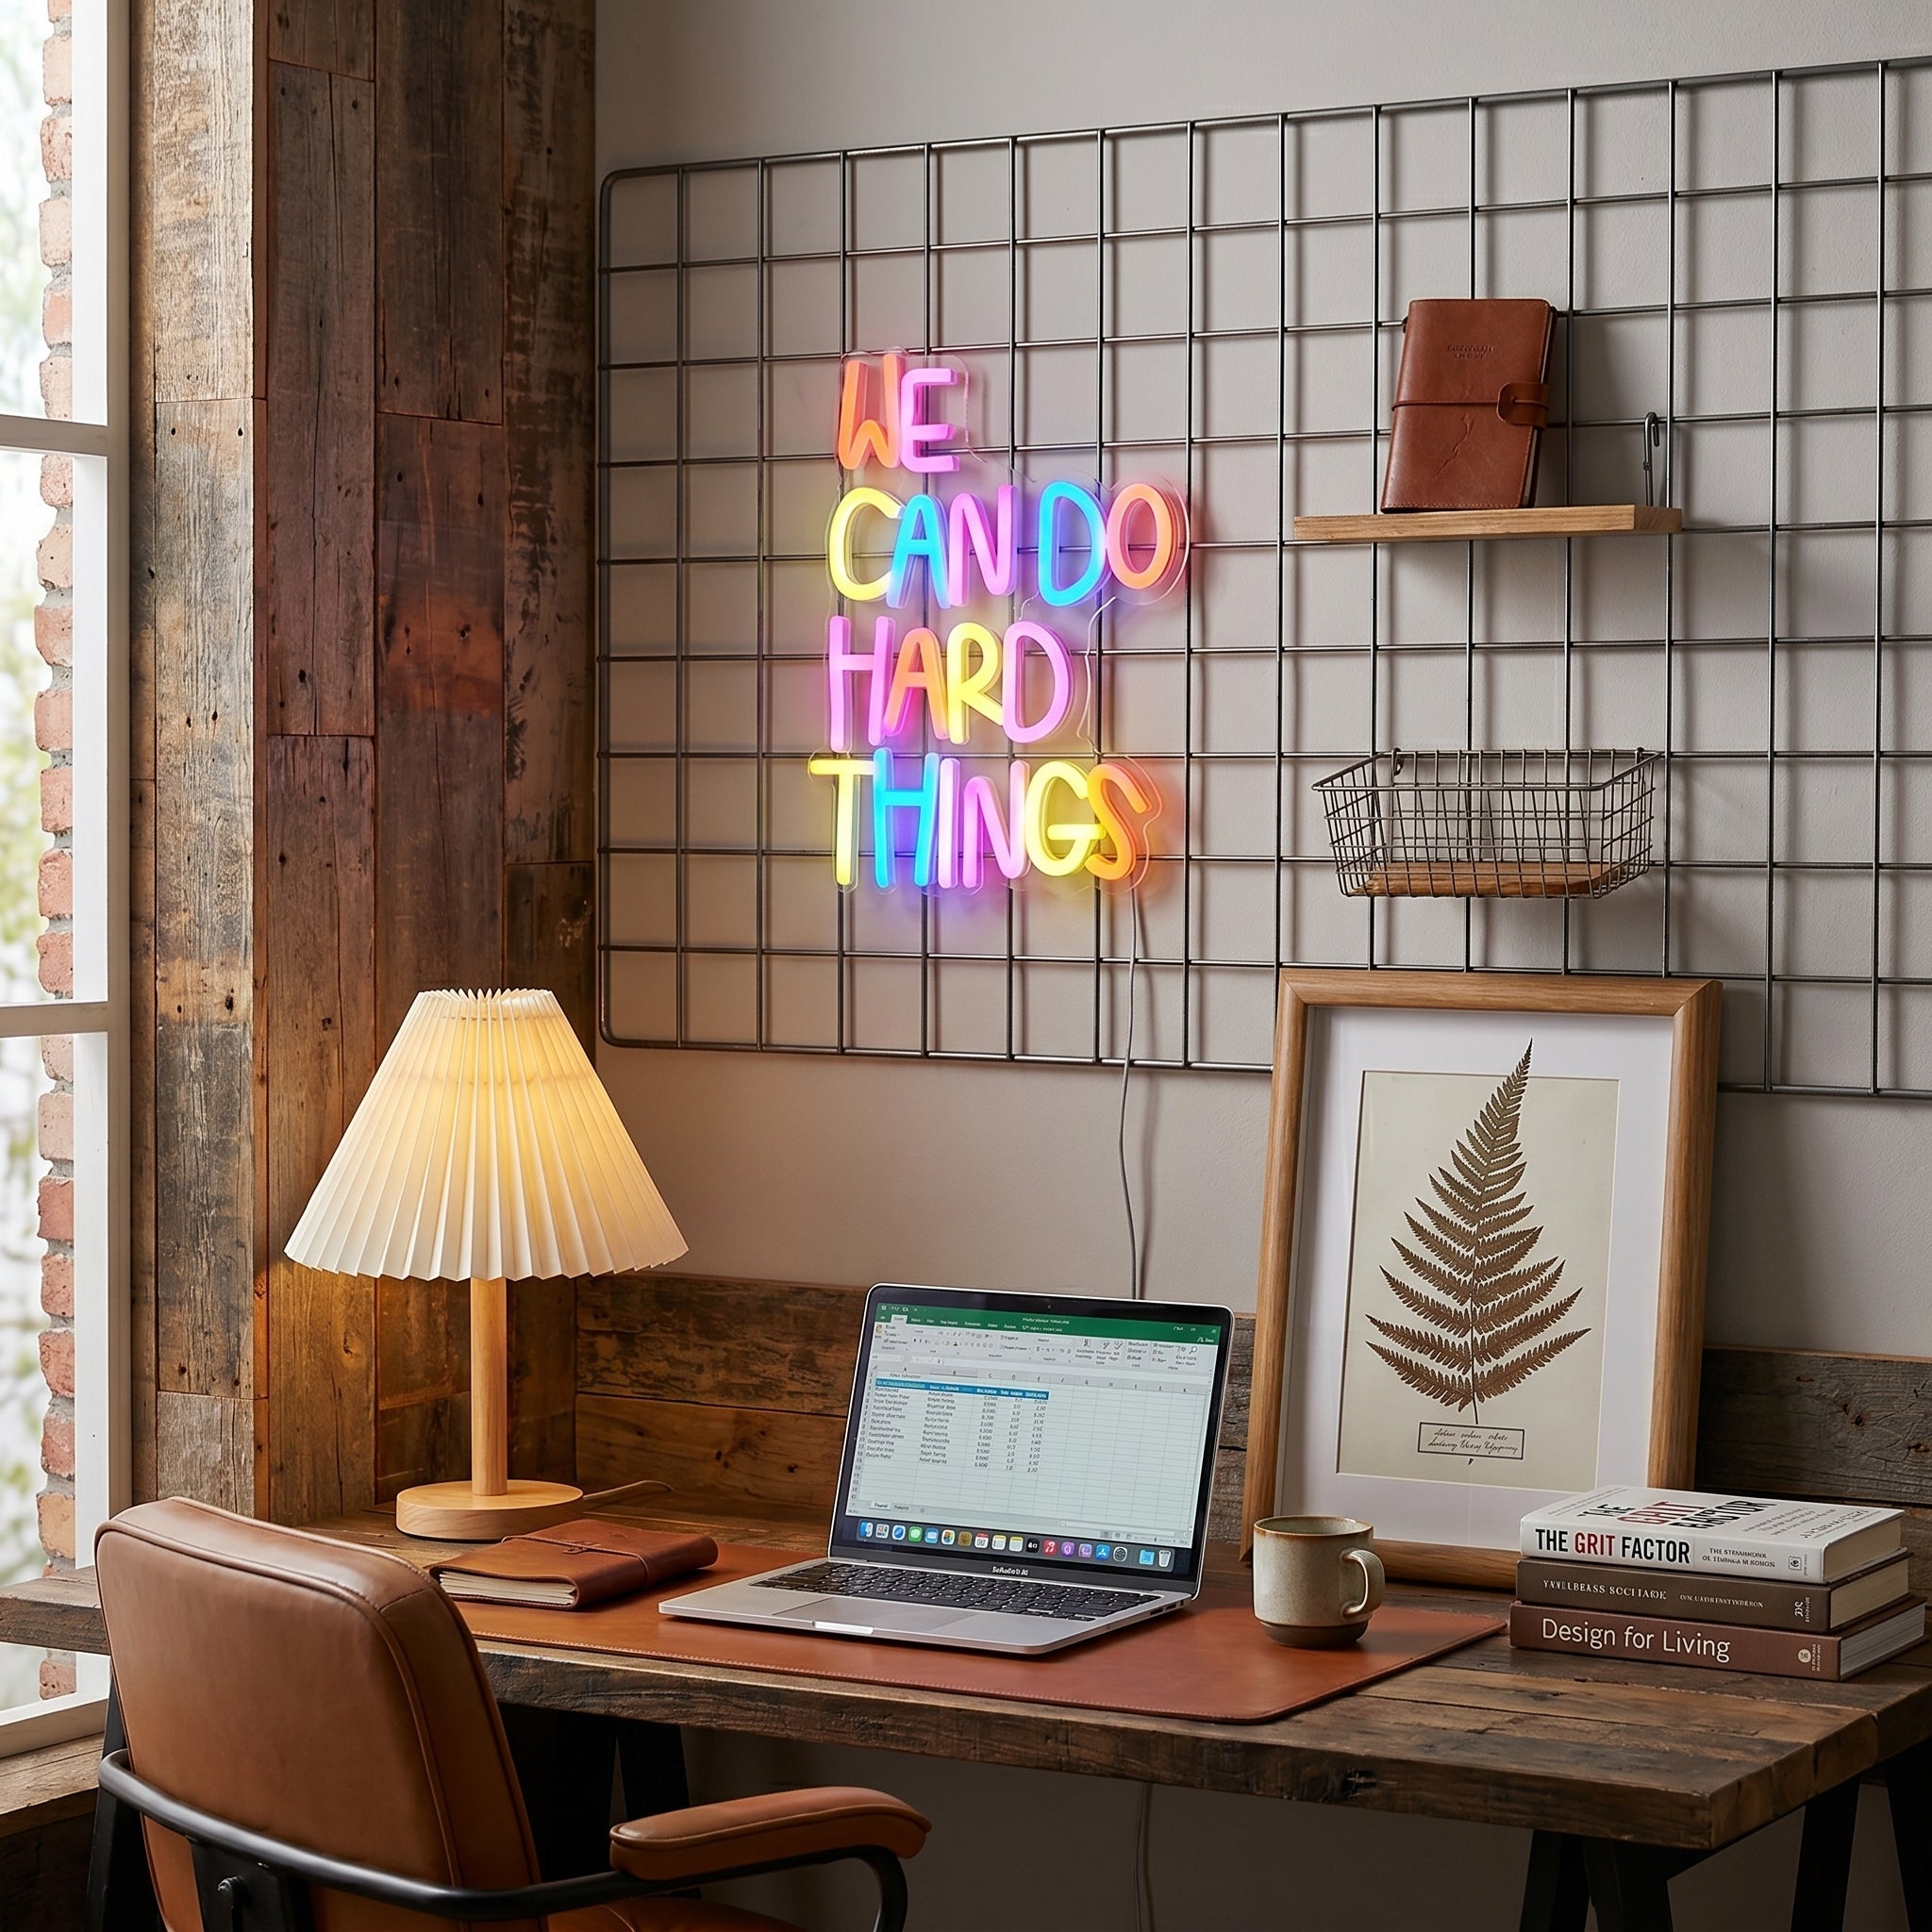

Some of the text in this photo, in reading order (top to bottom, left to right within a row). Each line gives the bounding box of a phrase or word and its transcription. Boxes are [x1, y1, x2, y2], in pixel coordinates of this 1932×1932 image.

[838, 354, 960, 474] WE
[829, 480, 1179, 609] CAN DO
[829, 615, 1074, 754] HARD
[809, 746, 1152, 890] THINGS
[1535, 1528, 1569, 1553] THE
[1574, 1532, 1616, 1557] GRIT
[1622, 1536, 1690, 1564] FACTOR
[1542, 1618, 1731, 1663] Design for Living
